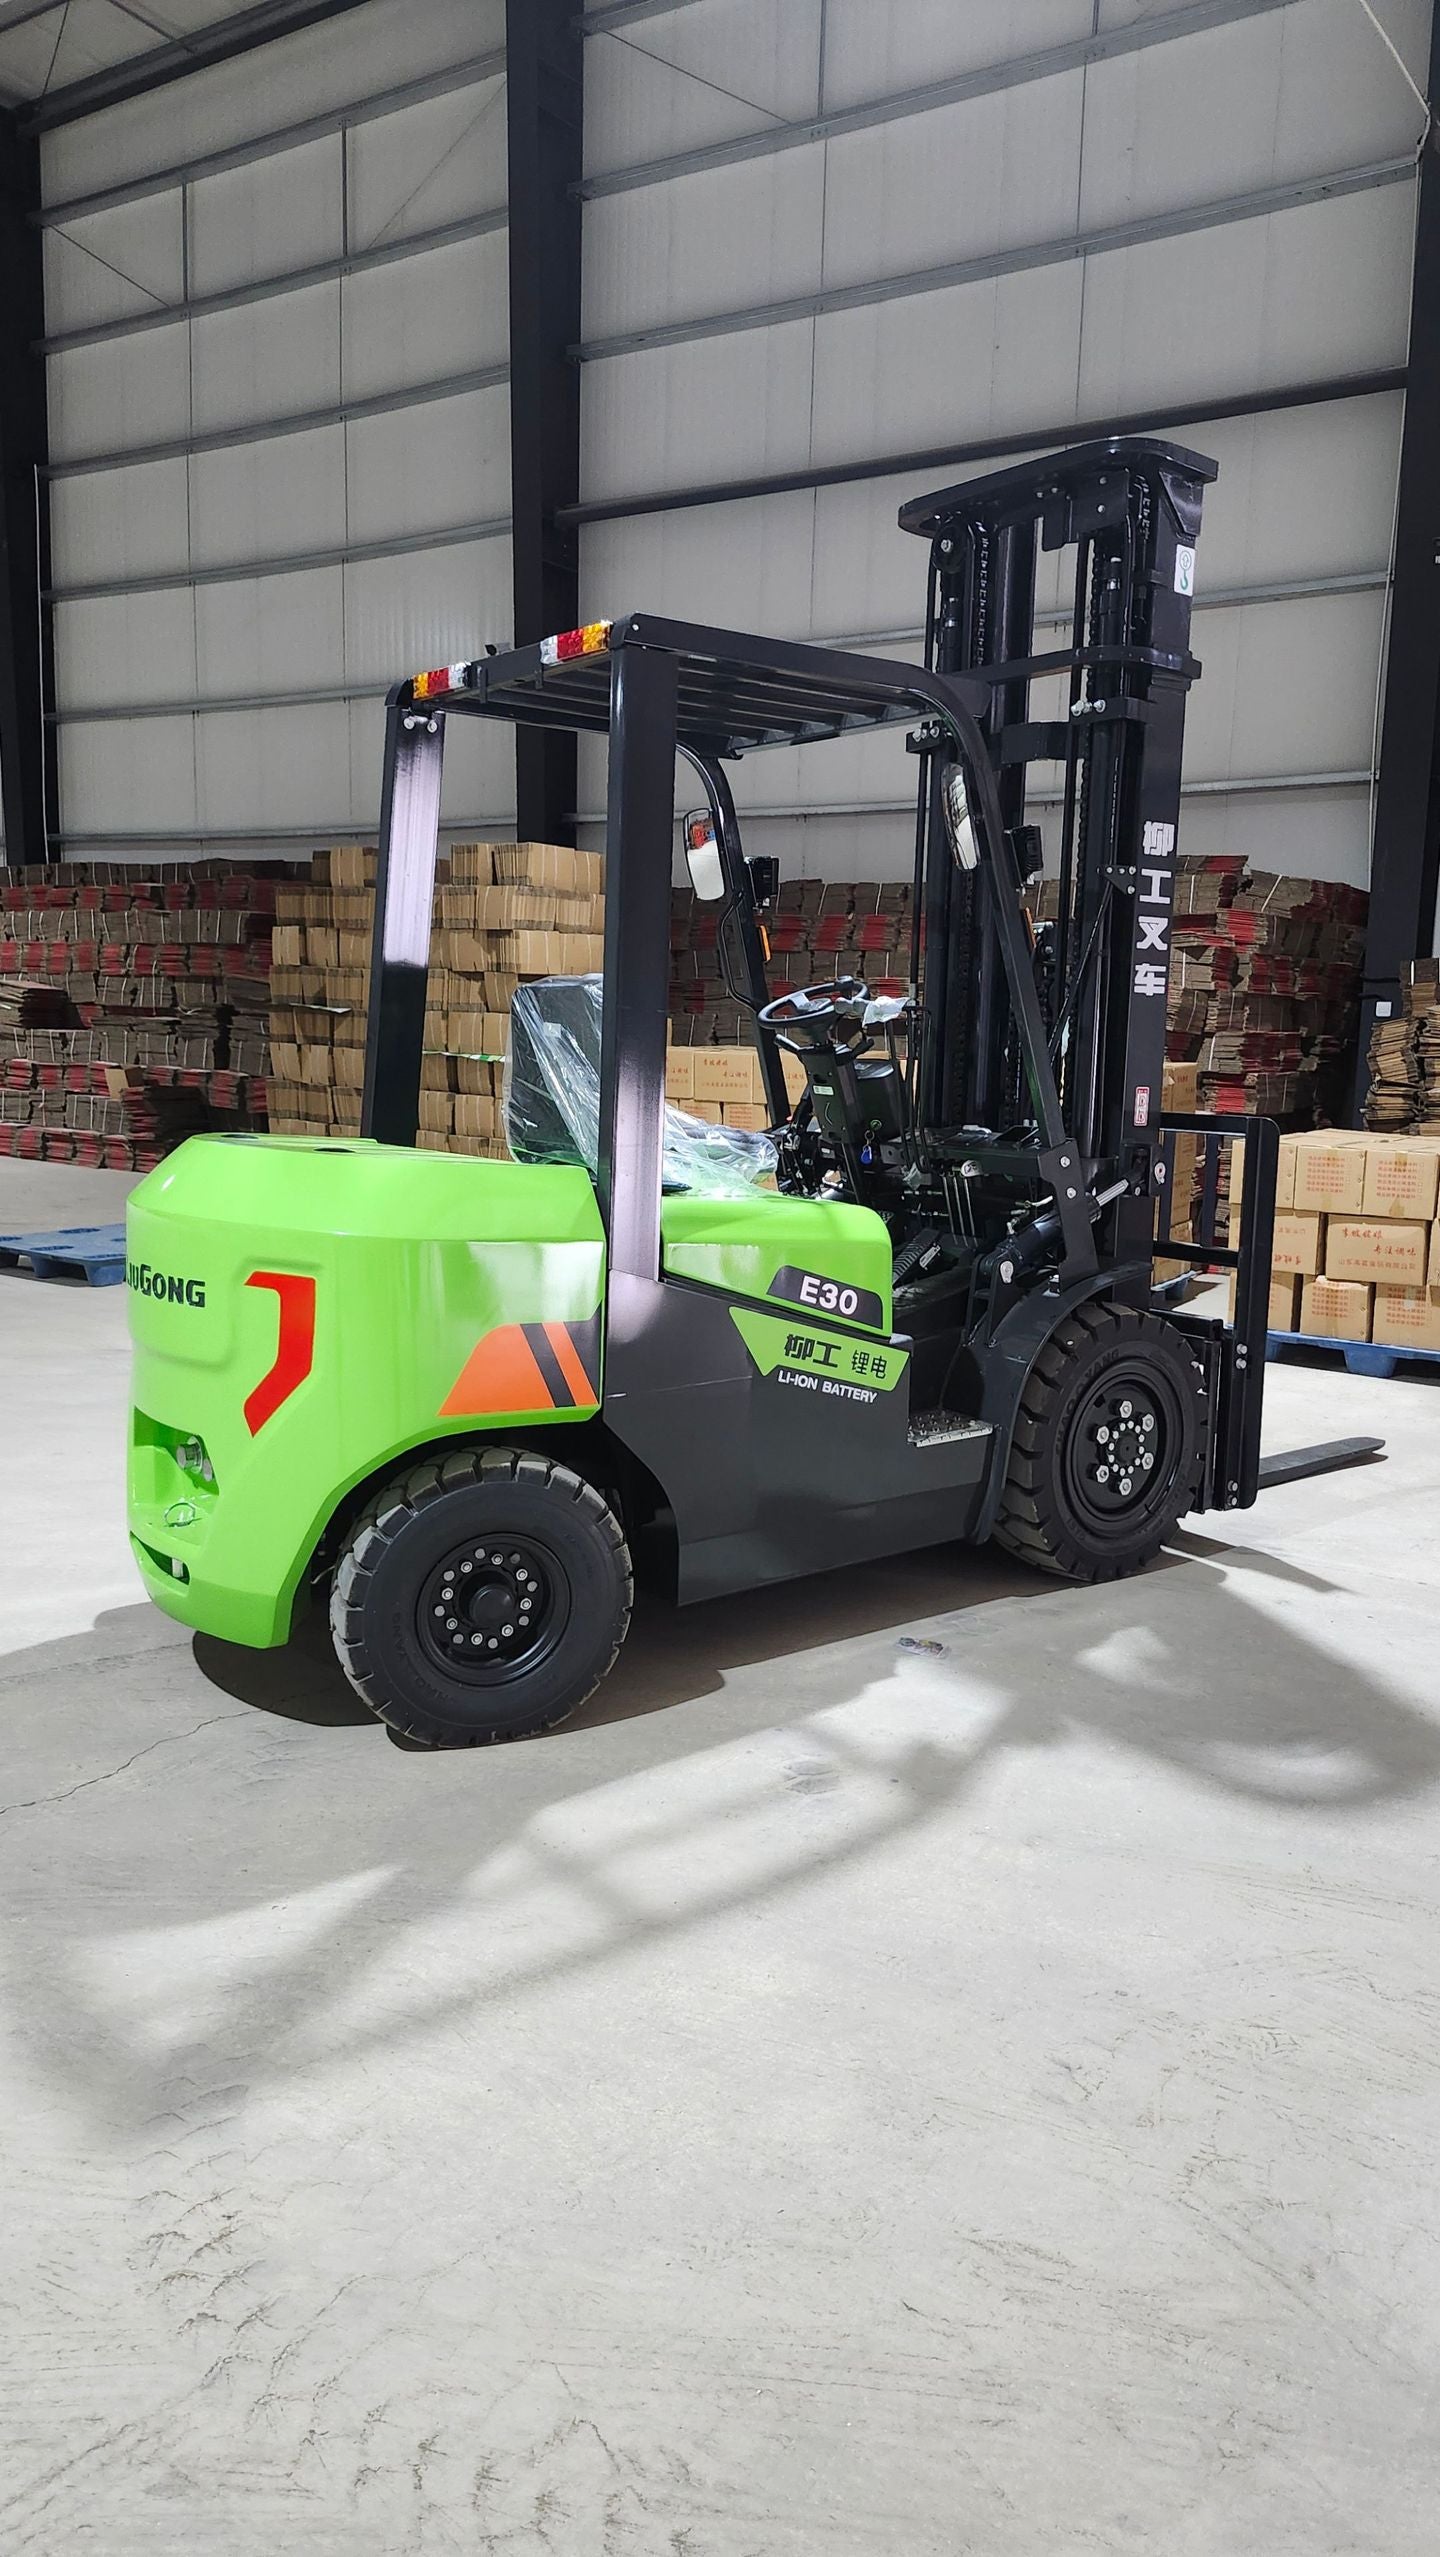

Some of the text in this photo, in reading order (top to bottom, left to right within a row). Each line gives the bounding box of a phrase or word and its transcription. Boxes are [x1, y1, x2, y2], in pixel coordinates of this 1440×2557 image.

[1134, 821, 1175, 996] 柳工叉车
[128, 1262, 205, 1308] IUGONG
[800, 1275, 858, 1315] E30
[784, 1333, 887, 1379] 柳工 锂电
[777, 1370, 877, 1404] LI-ION BATTERY
